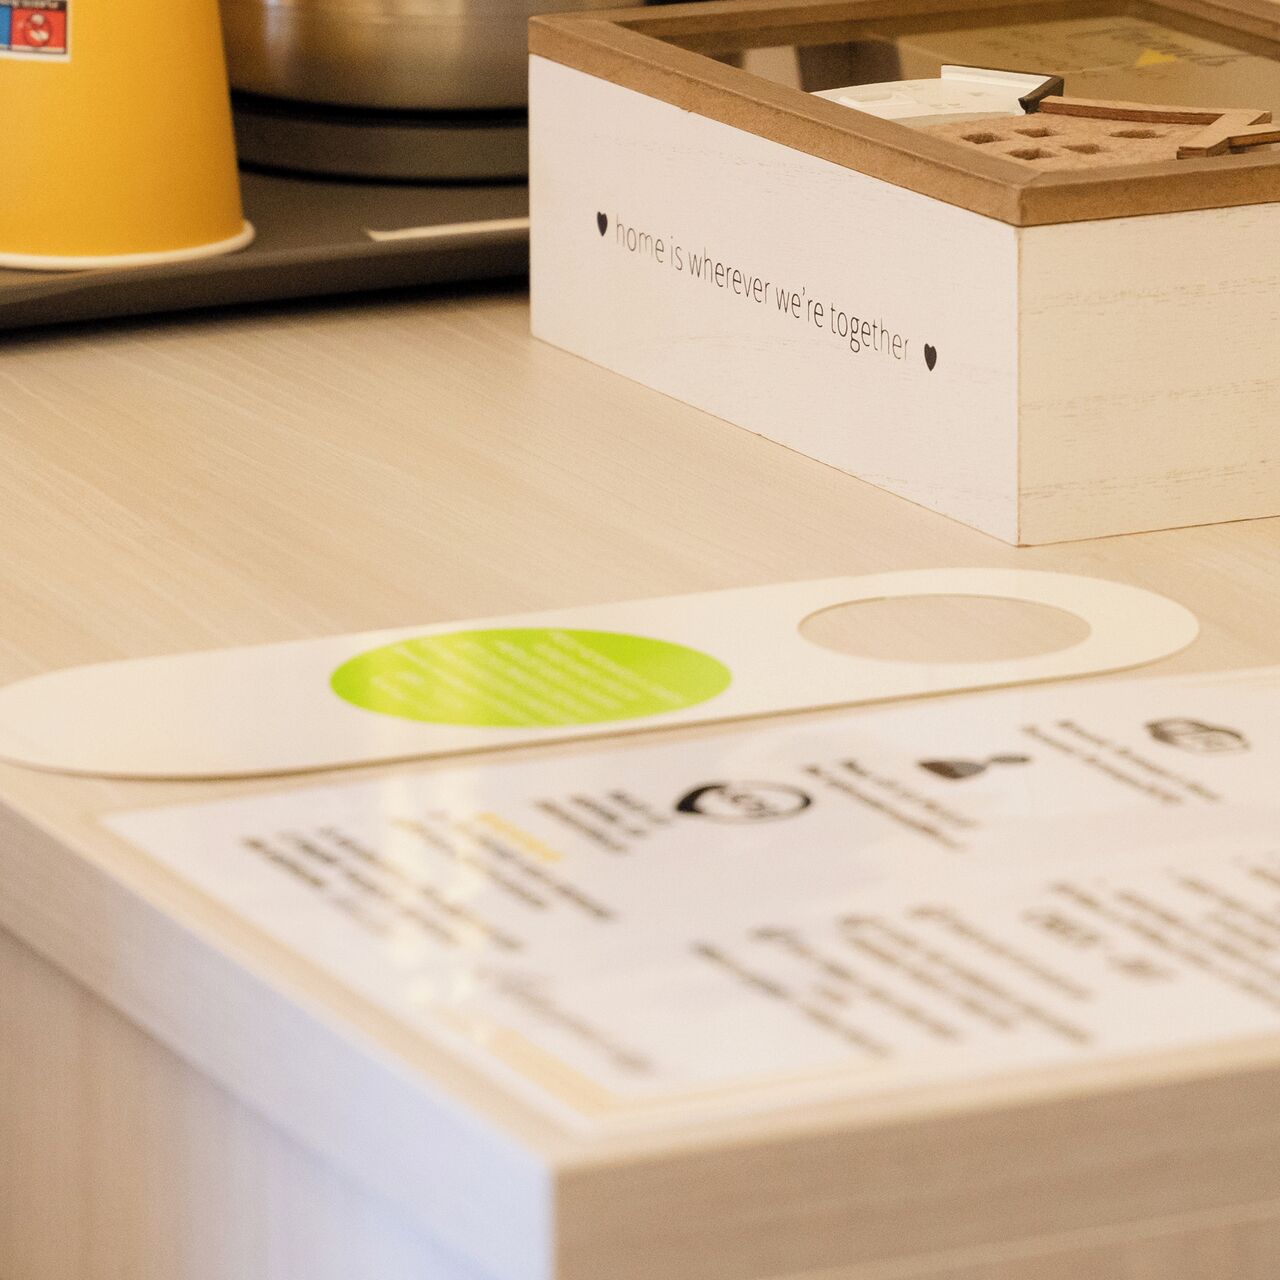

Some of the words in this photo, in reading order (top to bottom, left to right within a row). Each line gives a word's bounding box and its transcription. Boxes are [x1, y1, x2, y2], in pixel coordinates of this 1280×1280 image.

[616, 214, 665, 263] home
[670, 235, 683, 271] is
[688, 246, 771, 305] wherever
[775, 286, 824, 328] we're
[830, 302, 909, 361] together
